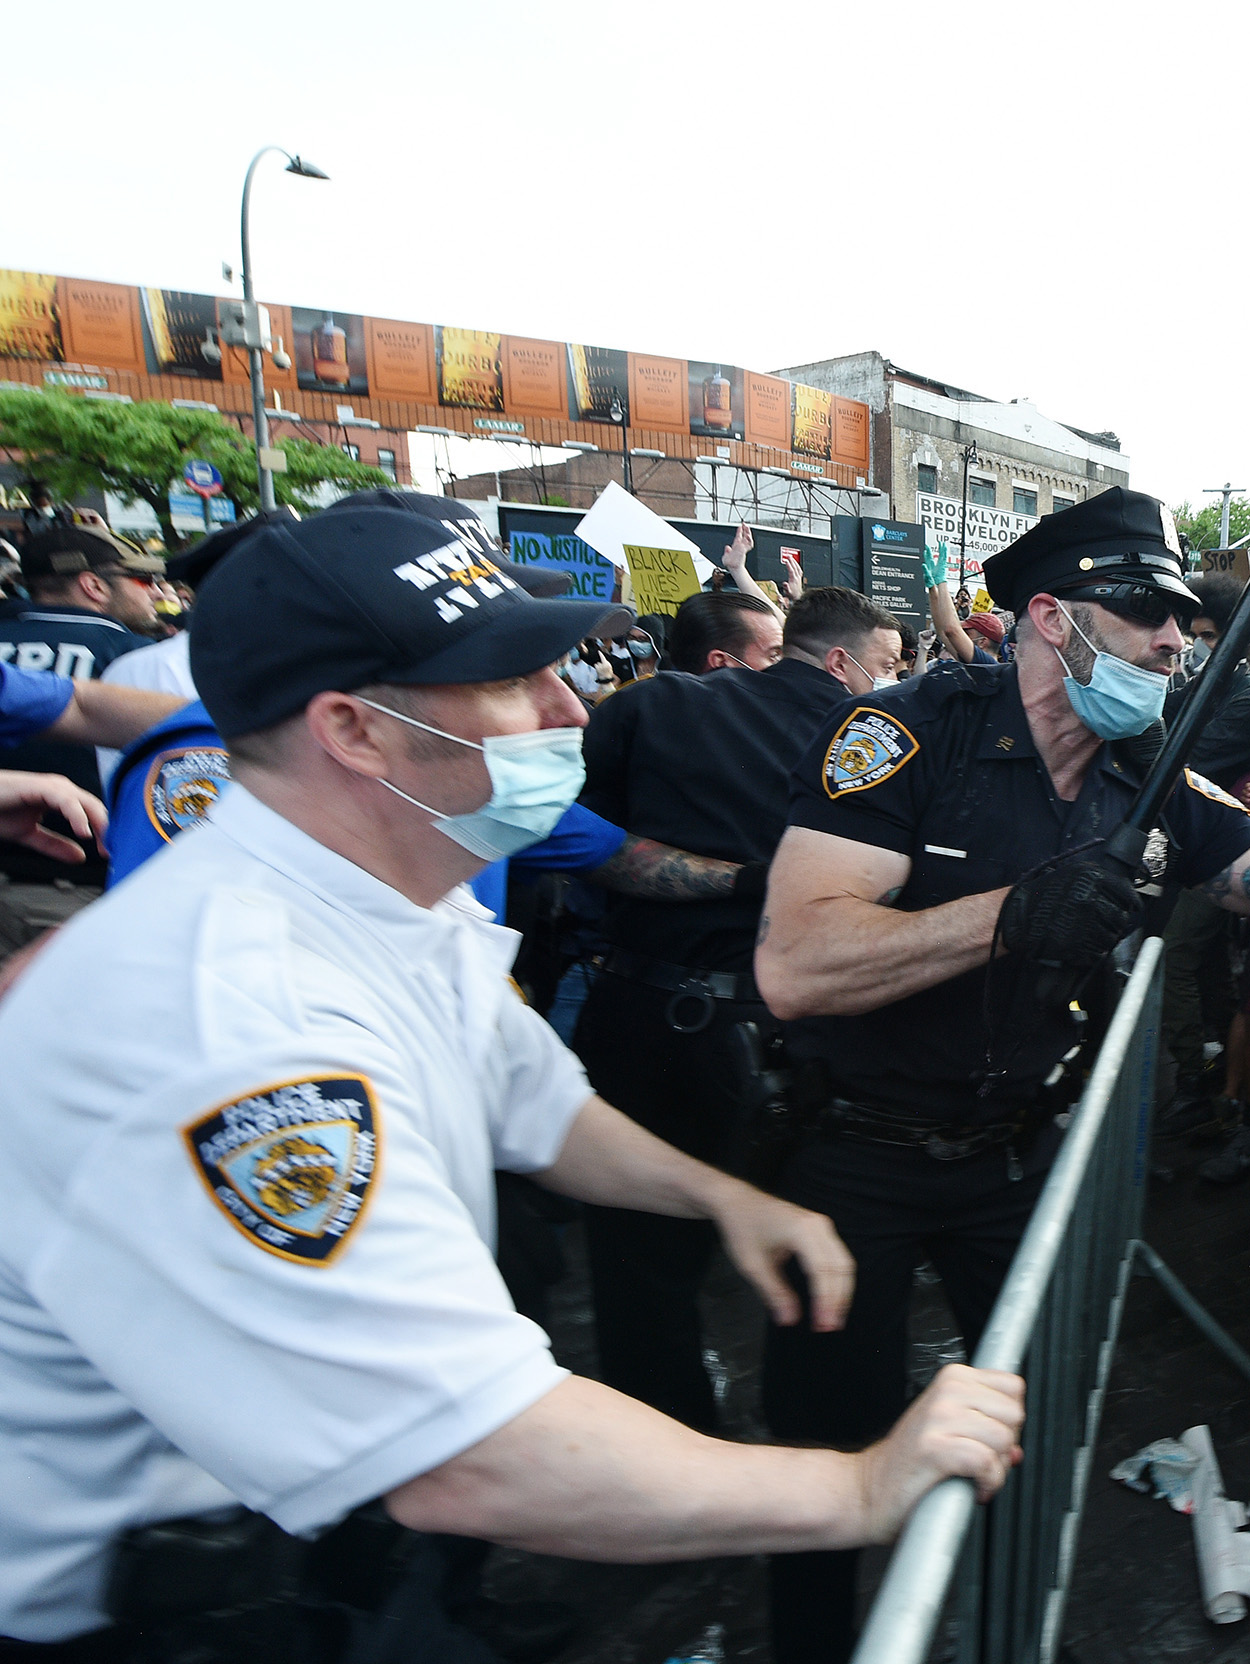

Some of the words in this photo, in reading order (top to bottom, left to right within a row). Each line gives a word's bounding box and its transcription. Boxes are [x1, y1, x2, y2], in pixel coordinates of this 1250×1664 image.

[638, 367, 678, 380] BULLEIT
[752, 384, 782, 397] BULLEIT
[838, 408, 863, 420] BULLEIT
[921, 498, 1010, 528] BROOKLYN
[1016, 518, 1039, 532] FL
[921, 515, 1024, 544] REDEVELOP
[513, 535, 540, 565] NO
[1204, 551, 1236, 572] STOP
[627, 548, 688, 576] BLACK
[564, 571, 607, 597] ACE
[640, 573, 681, 593] LIVES
[888, 571, 915, 579] ENTRANCE
[864, 715, 901, 740] POLICE
